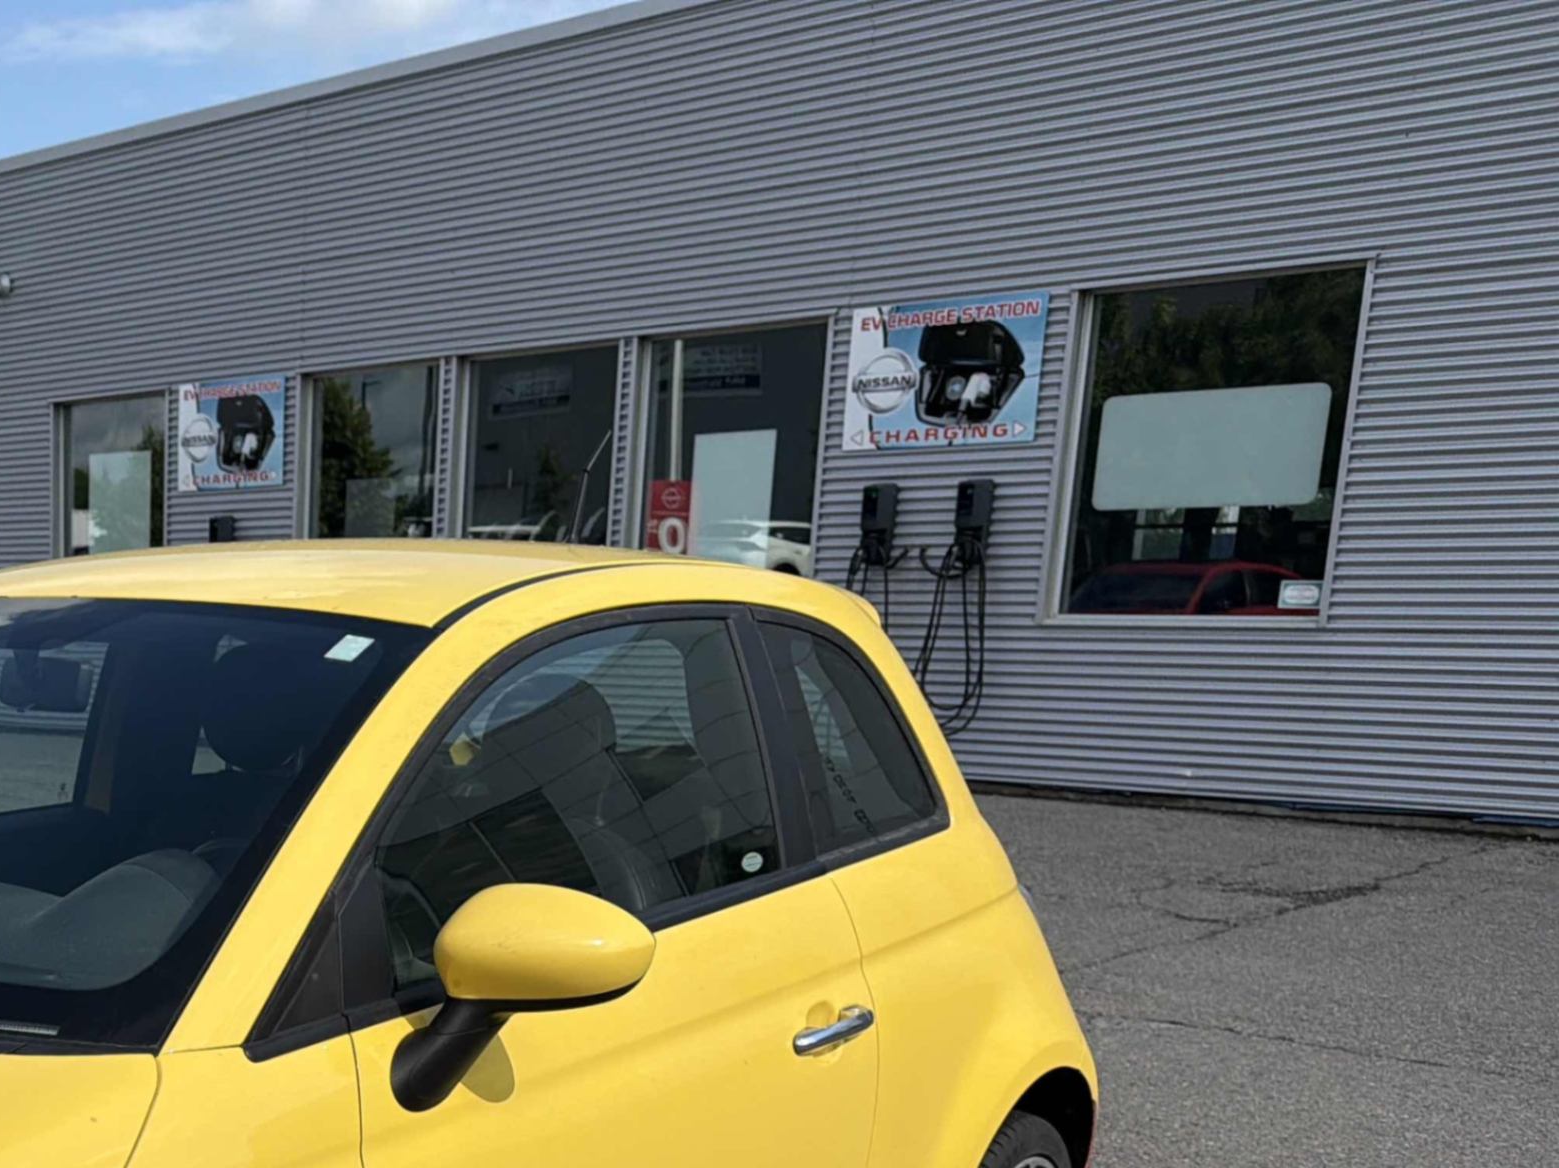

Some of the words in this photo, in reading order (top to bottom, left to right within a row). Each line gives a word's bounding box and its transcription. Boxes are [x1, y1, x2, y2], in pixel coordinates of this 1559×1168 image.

[861, 315, 883, 331] EV
[887, 308, 957, 329] CHARGE
[961, 301, 1040, 324] STATION
[858, 375, 912, 388] NISSAN
[868, 423, 1009, 444] CHARGING
[192, 470, 269, 485] CHARGING
